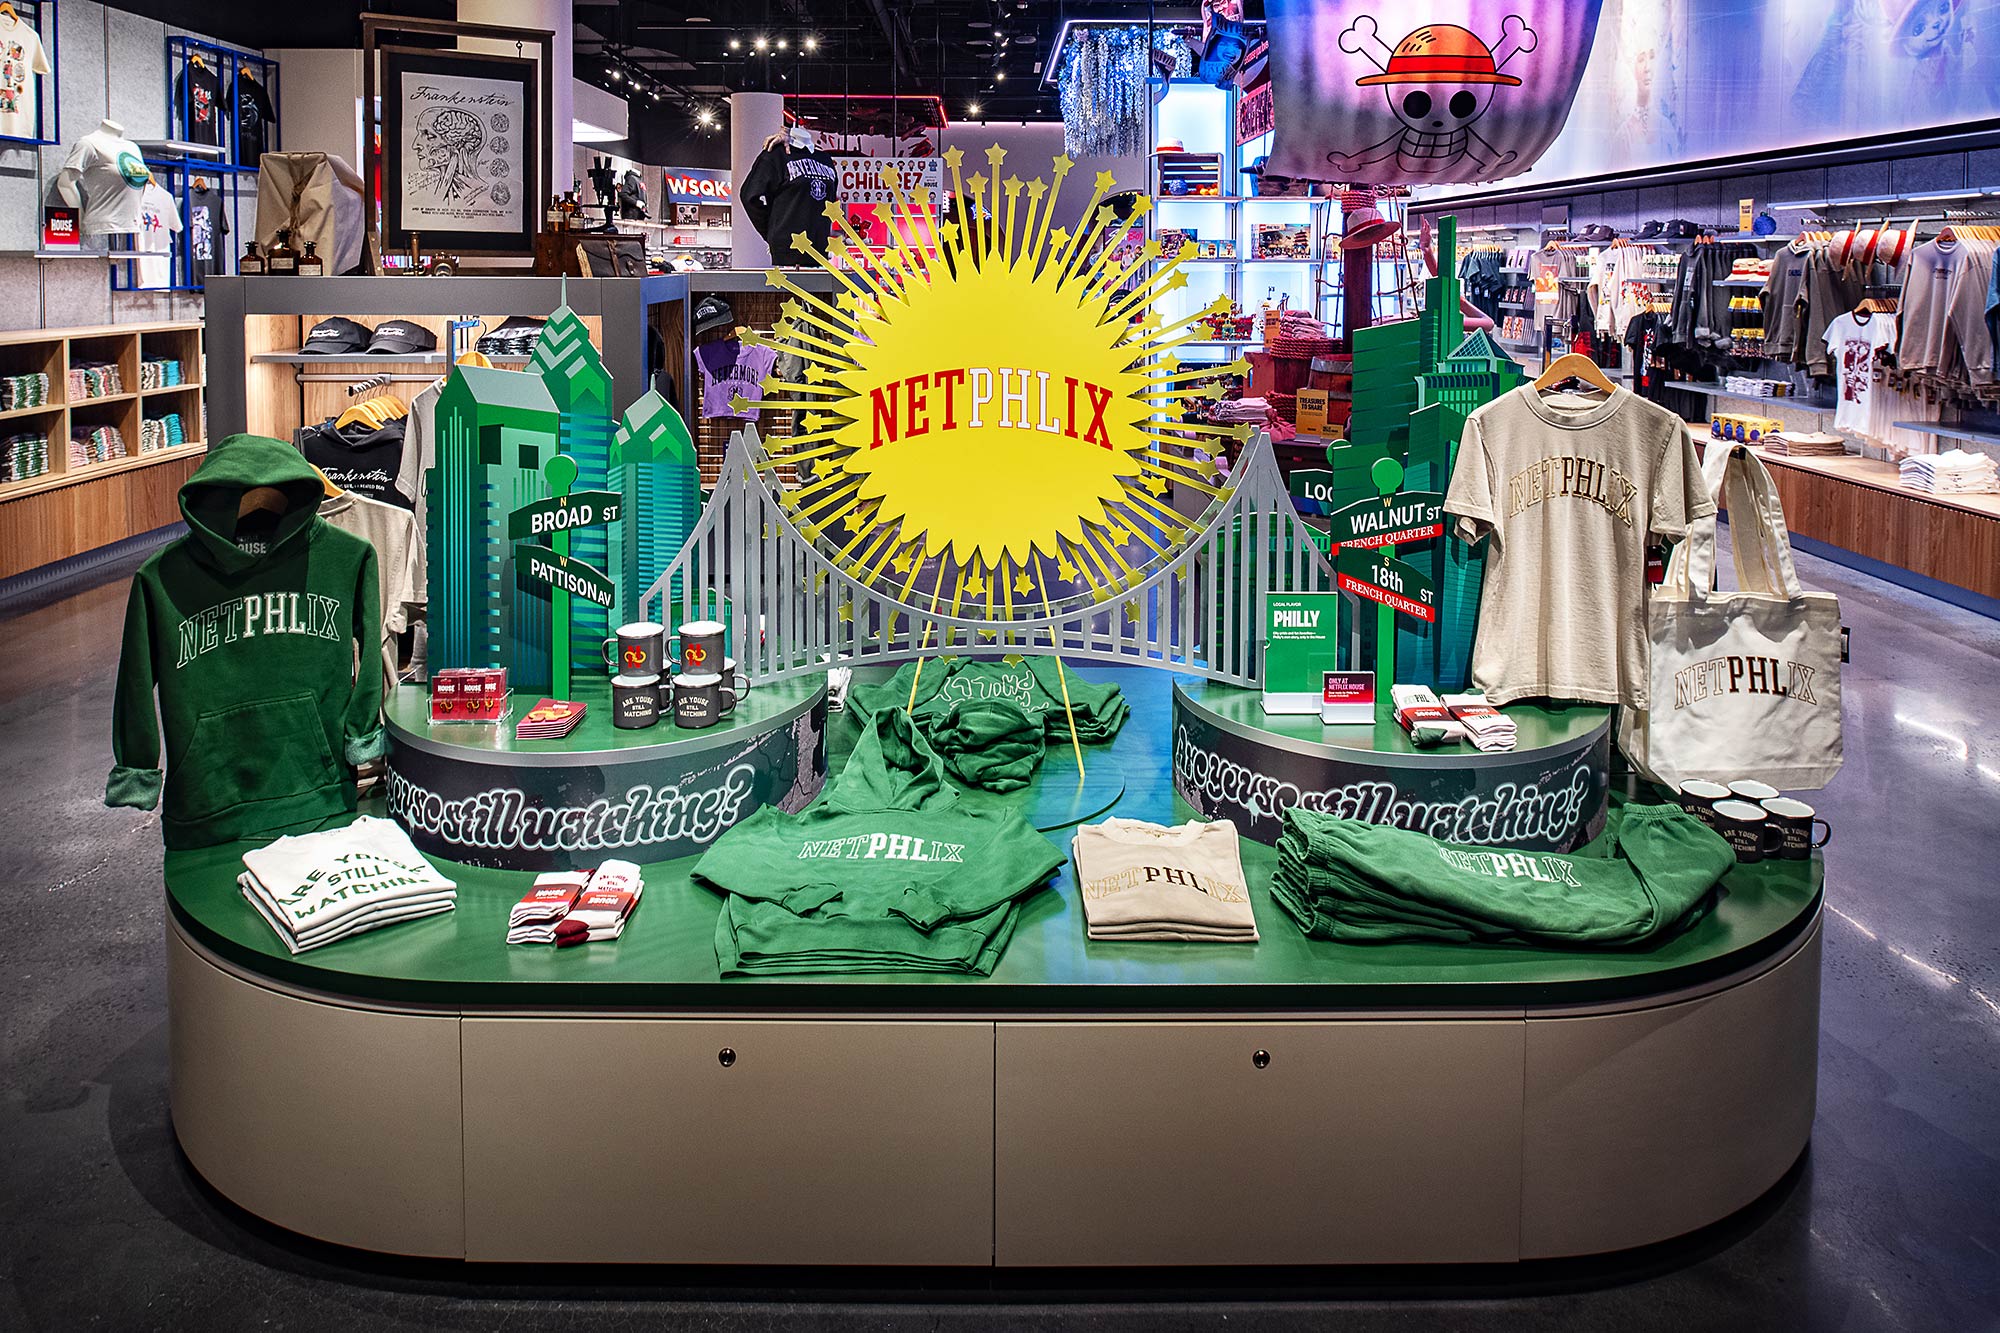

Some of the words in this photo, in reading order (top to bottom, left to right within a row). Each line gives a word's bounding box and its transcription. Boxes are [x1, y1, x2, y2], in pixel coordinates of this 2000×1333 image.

[410, 86, 514, 106] Frankenstein
[51, 218, 73, 232] HOUSE
[870, 367, 1113, 451] NETPHLIX
[560, 496, 567, 507] N
[1383, 497, 1392, 508] W
[531, 504, 593, 534] BROAD
[603, 506, 618, 521] ST
[1350, 503, 1426, 535] WALNUT
[1426, 506, 1442, 521] ST
[1340, 534, 1384, 549] FRENCH
[1385, 525, 1435, 545] QUARTER
[559, 555, 568, 567] W
[1383, 556, 1390, 567] S
[530, 558, 597, 601] PATTISON
[597, 590, 611, 606] AV
[1371, 564, 1404, 594] 18th
[1420, 588, 1434, 604] ST
[1345, 578, 1384, 602] FRENCH
[1385, 595, 1428, 618] QUARTER
[176, 591, 340, 669] NETPHLIX
[1273, 610, 1320, 628] PHILLY
[1674, 655, 1818, 710] NETPHLIX
[622, 698, 634, 708] ARE
[635, 696, 654, 705] YOUSE
[678, 697, 689, 705] ARE
[689, 696, 709, 706] YOUSE
[624, 709, 652, 717] WATCHING
[680, 709, 707, 718] WATCHING
[1723, 829, 1737, 838] ARE
[1737, 830, 1759, 842] YOUSE
[1791, 828, 1809, 839] YOUSE
[797, 832, 965, 863] NETPHLIX
[327, 864, 389, 887] STILL
[1432, 840, 1582, 888] NETPHLIX
[278, 868, 327, 906] ARE
[334, 853, 426, 875] YOUSE
[1084, 866, 1247, 904] NETPHLIX
